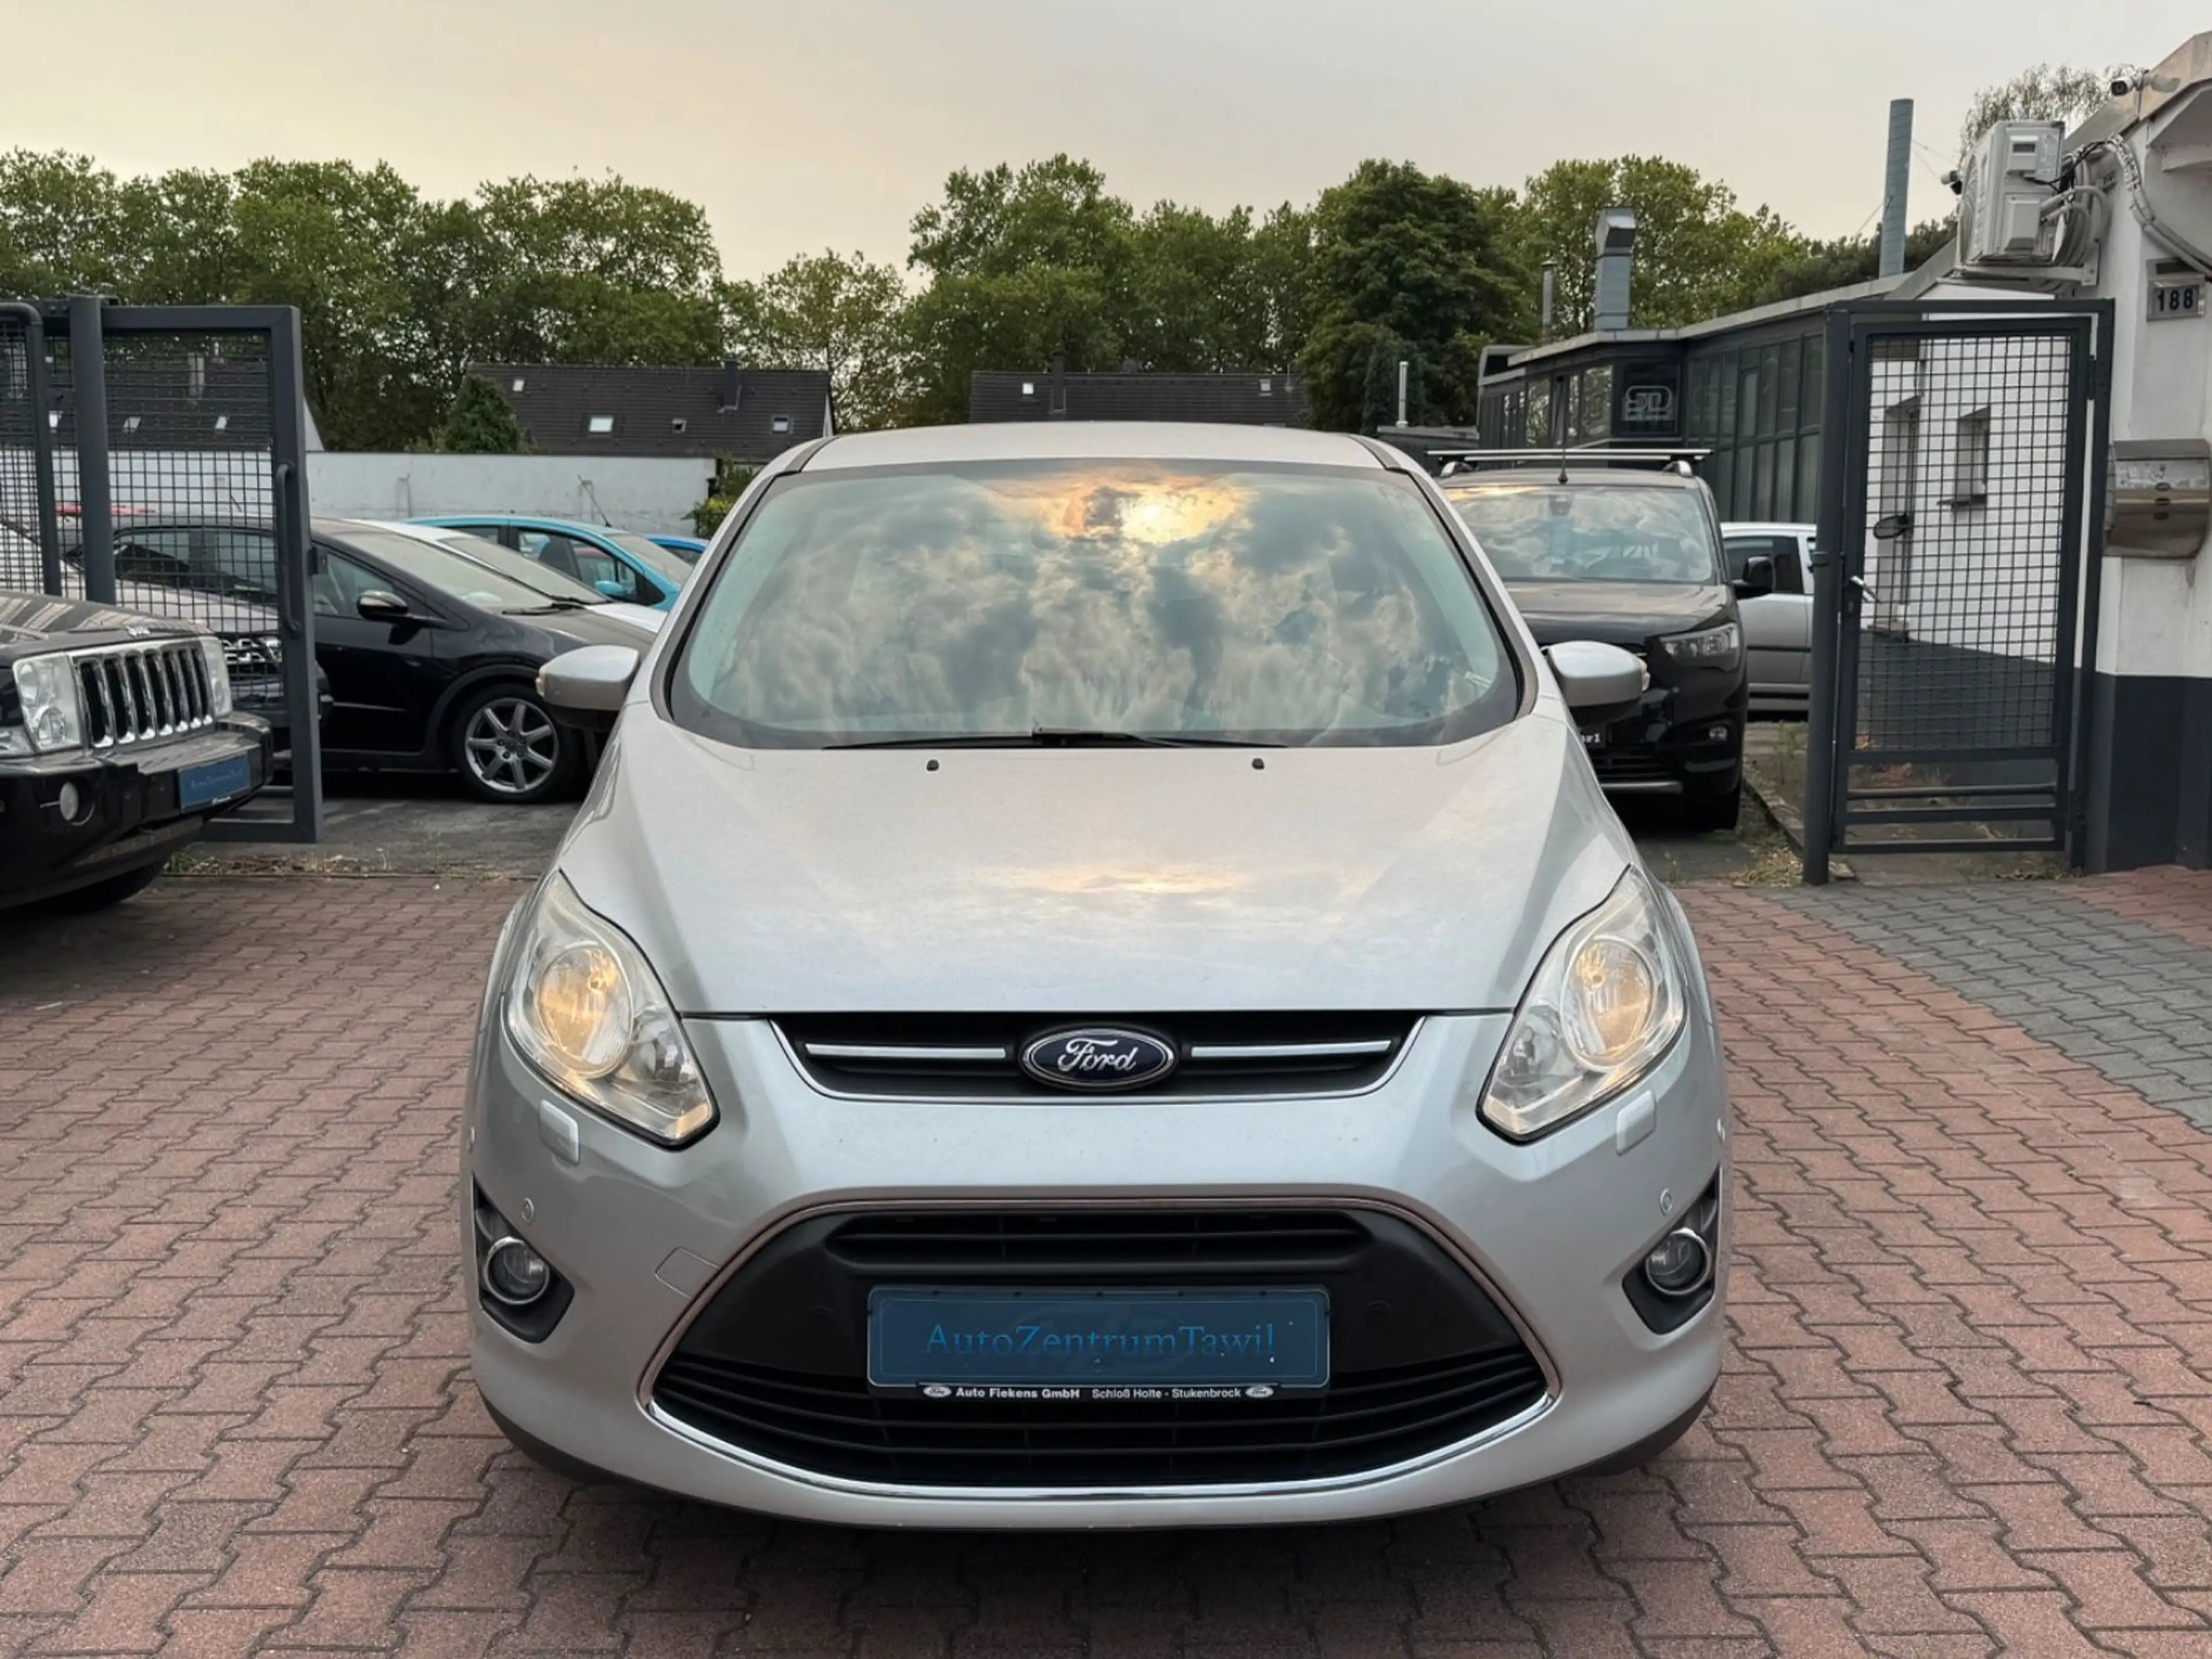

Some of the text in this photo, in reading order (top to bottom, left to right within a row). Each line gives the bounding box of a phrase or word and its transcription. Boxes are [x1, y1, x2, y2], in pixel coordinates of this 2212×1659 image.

[2157, 289, 2194, 311] 188
[1057, 1037, 1139, 1072] Ford
[924, 1323, 1276, 1355] AutoZentrumTawil
[956, 1387, 986, 1398] Auto
[989, 1387, 1037, 1399] Fiekens
[1041, 1388, 1080, 1399] GmbH
[1133, 1388, 1162, 1399] Holte
[1172, 1387, 1241, 1399] Stukenbrock
